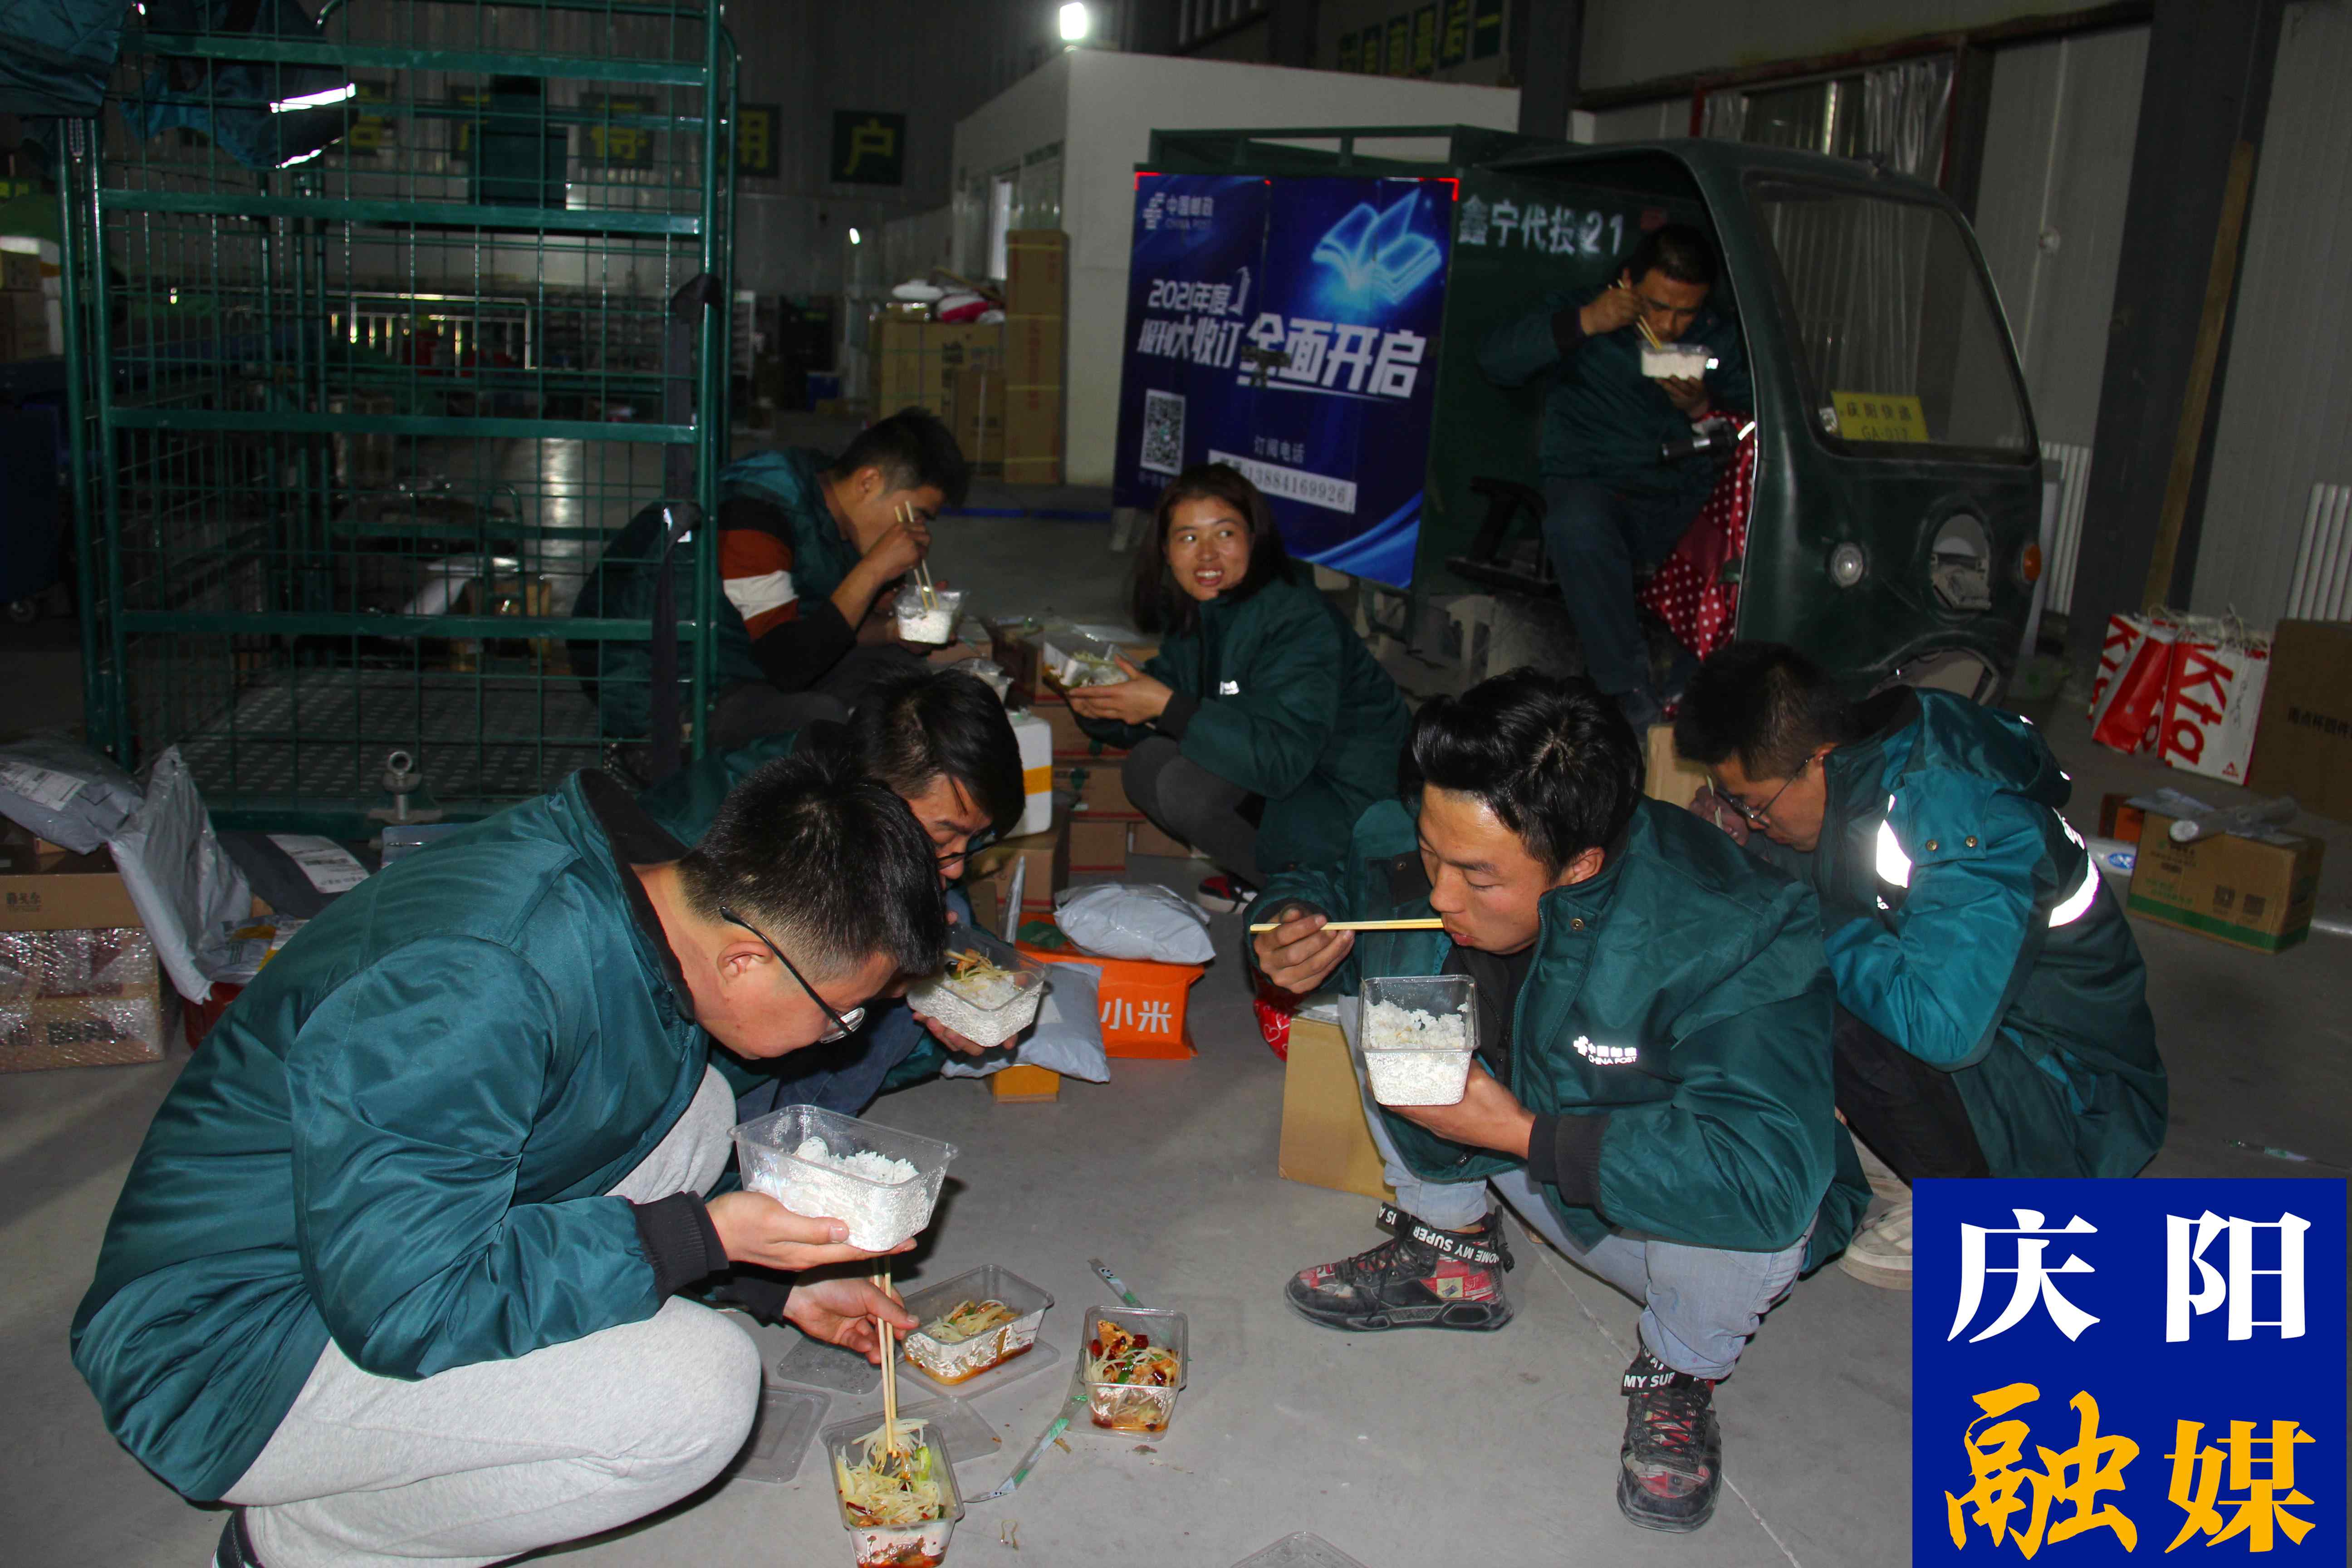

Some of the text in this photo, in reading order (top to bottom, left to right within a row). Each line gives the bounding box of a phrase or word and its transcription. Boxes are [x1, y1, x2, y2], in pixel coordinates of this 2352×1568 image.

[1238, 312, 1427, 399] 全面开启
[1099, 998, 1173, 1034] 小米
[1588, 1054, 1637, 1065] CHINA POST
[1385, 1210, 1398, 1226] IS
[1412, 1225, 1454, 1253] SUPER
[1454, 1244, 1475, 1260] MY
[1623, 1374, 1648, 1389] MY
